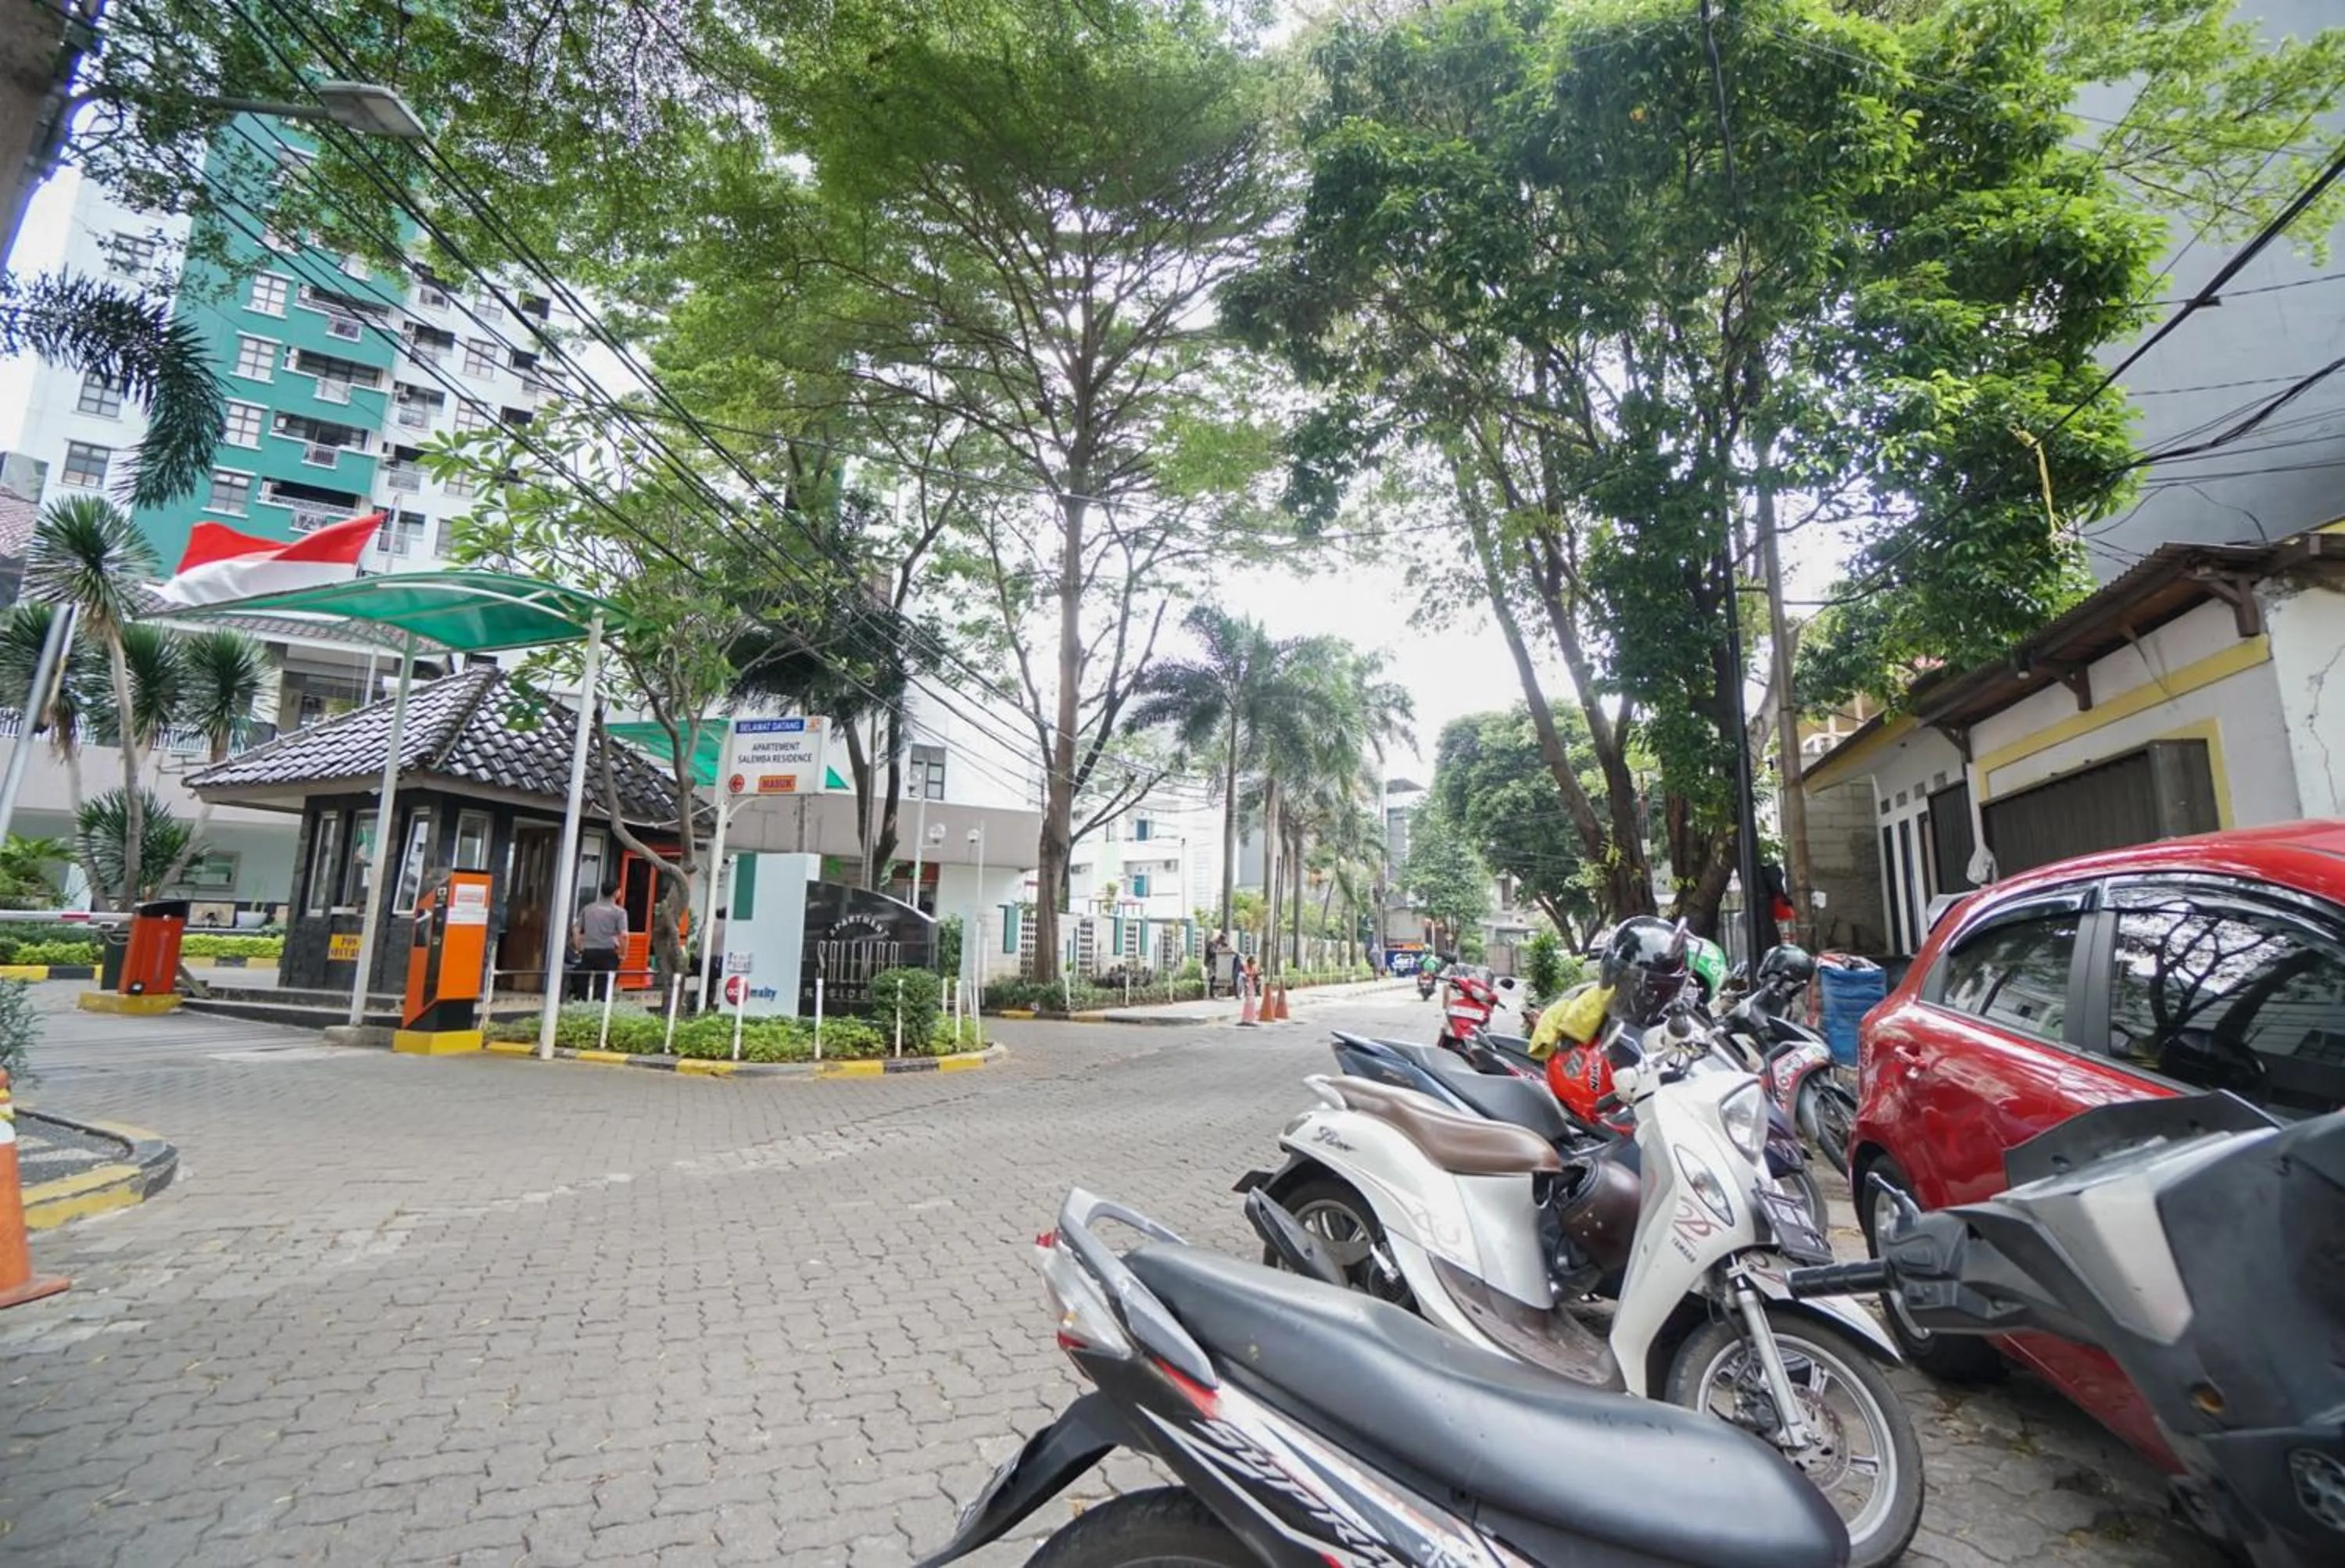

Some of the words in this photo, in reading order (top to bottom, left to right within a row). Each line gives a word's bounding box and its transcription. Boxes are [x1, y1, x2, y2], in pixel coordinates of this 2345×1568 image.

[739, 722, 769, 732] SELAMAT
[772, 721, 801, 730] DATANG
[752, 742, 800, 751] APARTEMENT
[738, 754, 771, 764] SALEMBA
[772, 753, 813, 763] RESIDENCE
[762, 779, 793, 788] MASUK
